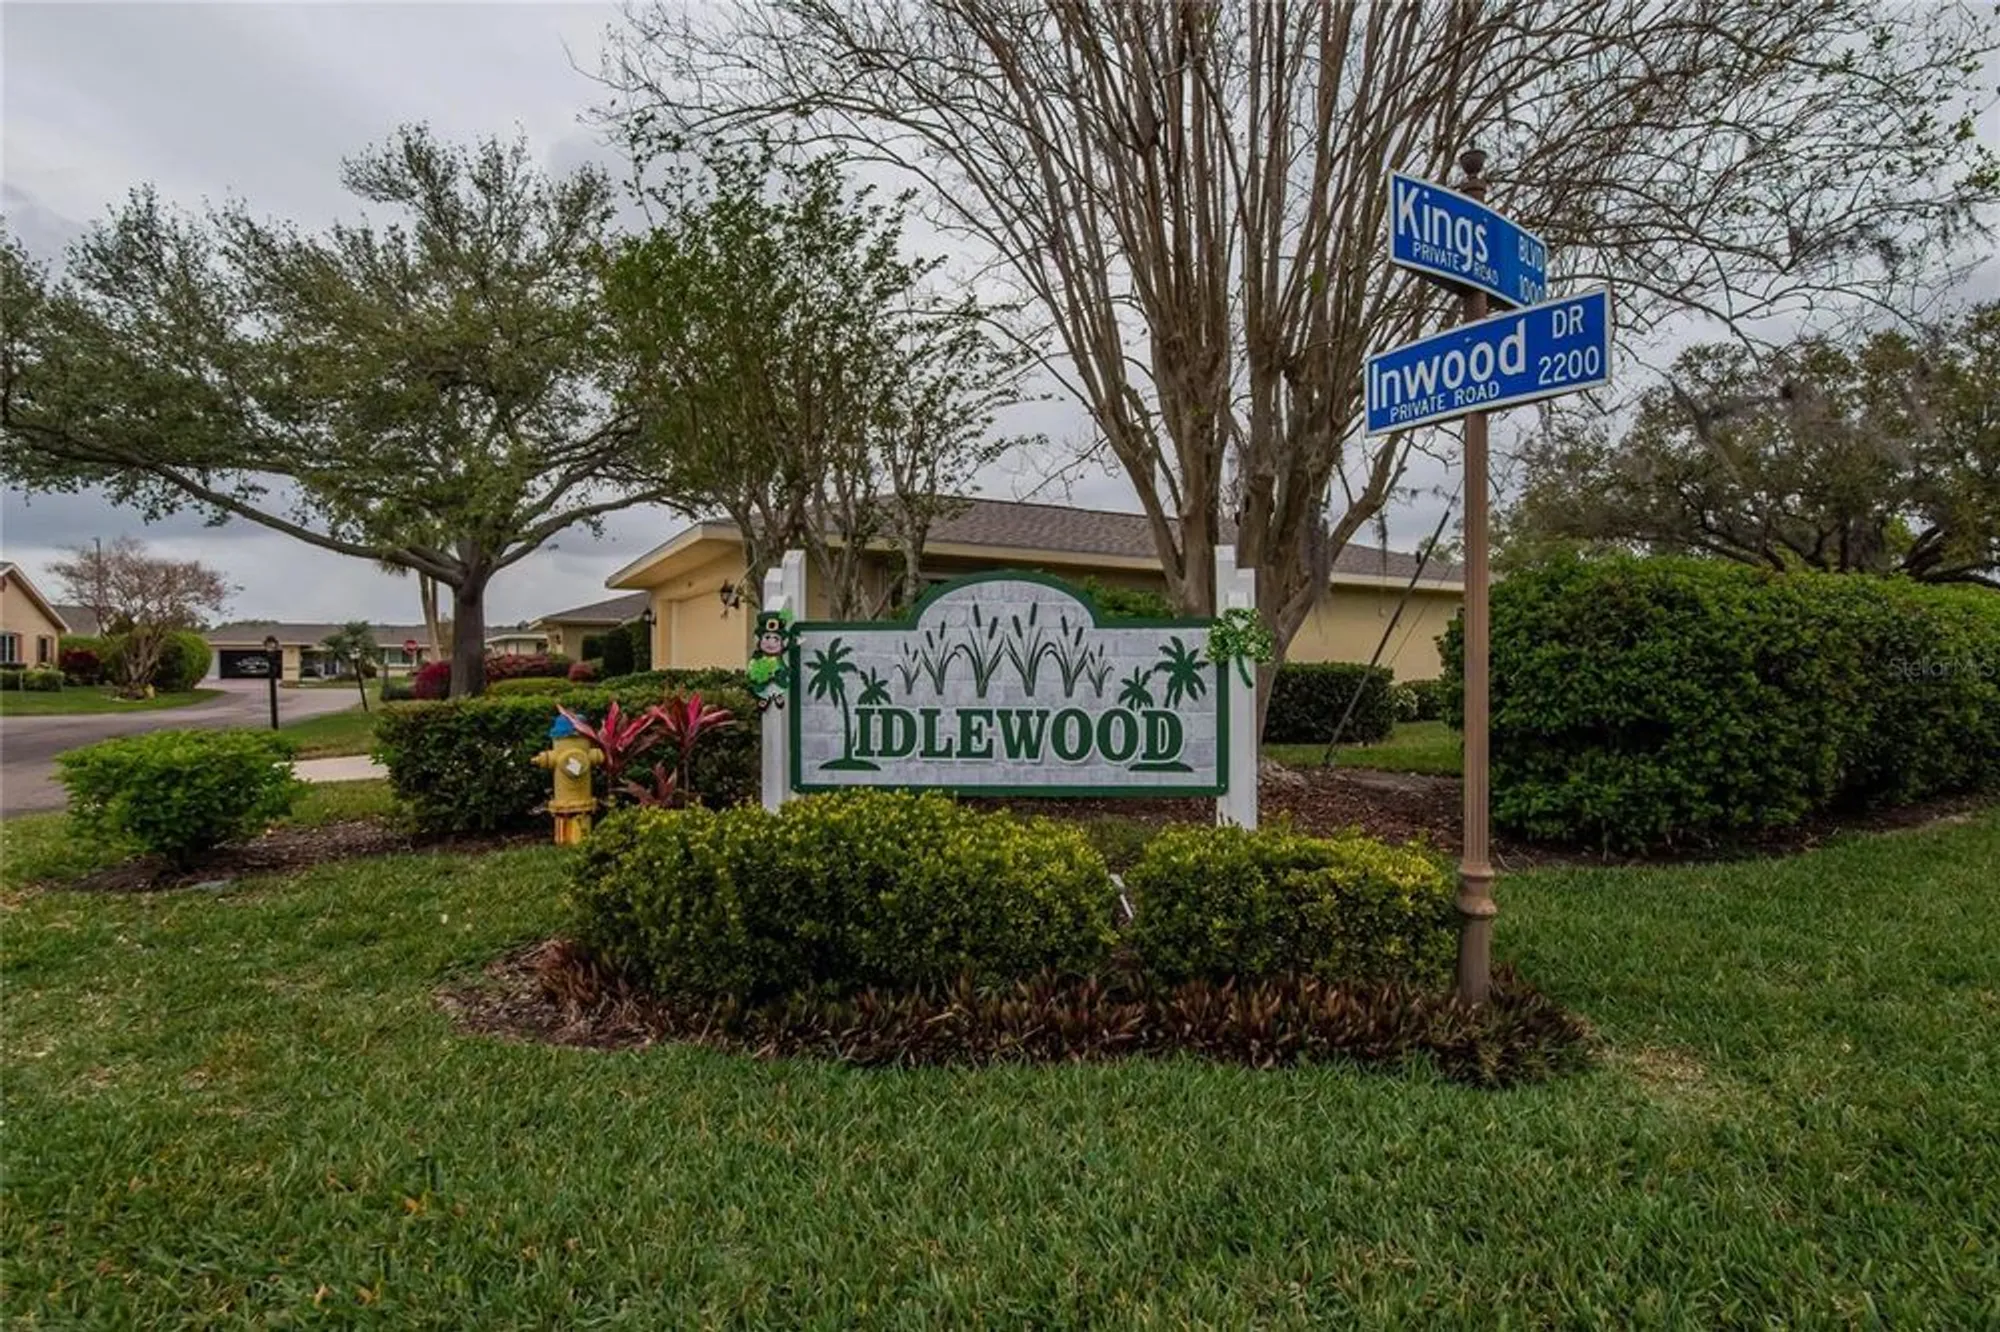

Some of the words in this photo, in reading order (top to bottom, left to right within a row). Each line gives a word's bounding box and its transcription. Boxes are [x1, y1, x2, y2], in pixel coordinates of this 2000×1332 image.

[1397, 181, 1489, 273] Kings
[1412, 240, 1461, 273] PRIVATE
[1473, 262, 1499, 287] ROAD
[1518, 235, 1544, 273] BLVD
[1371, 318, 1527, 412] Inwood
[1551, 303, 1584, 340] DR
[1537, 345, 1601, 386] 2200
[1389, 392, 1447, 424] PRIVATE
[1453, 380, 1500, 407] ROAD
[853, 706, 1185, 763] IDLEWOOD
